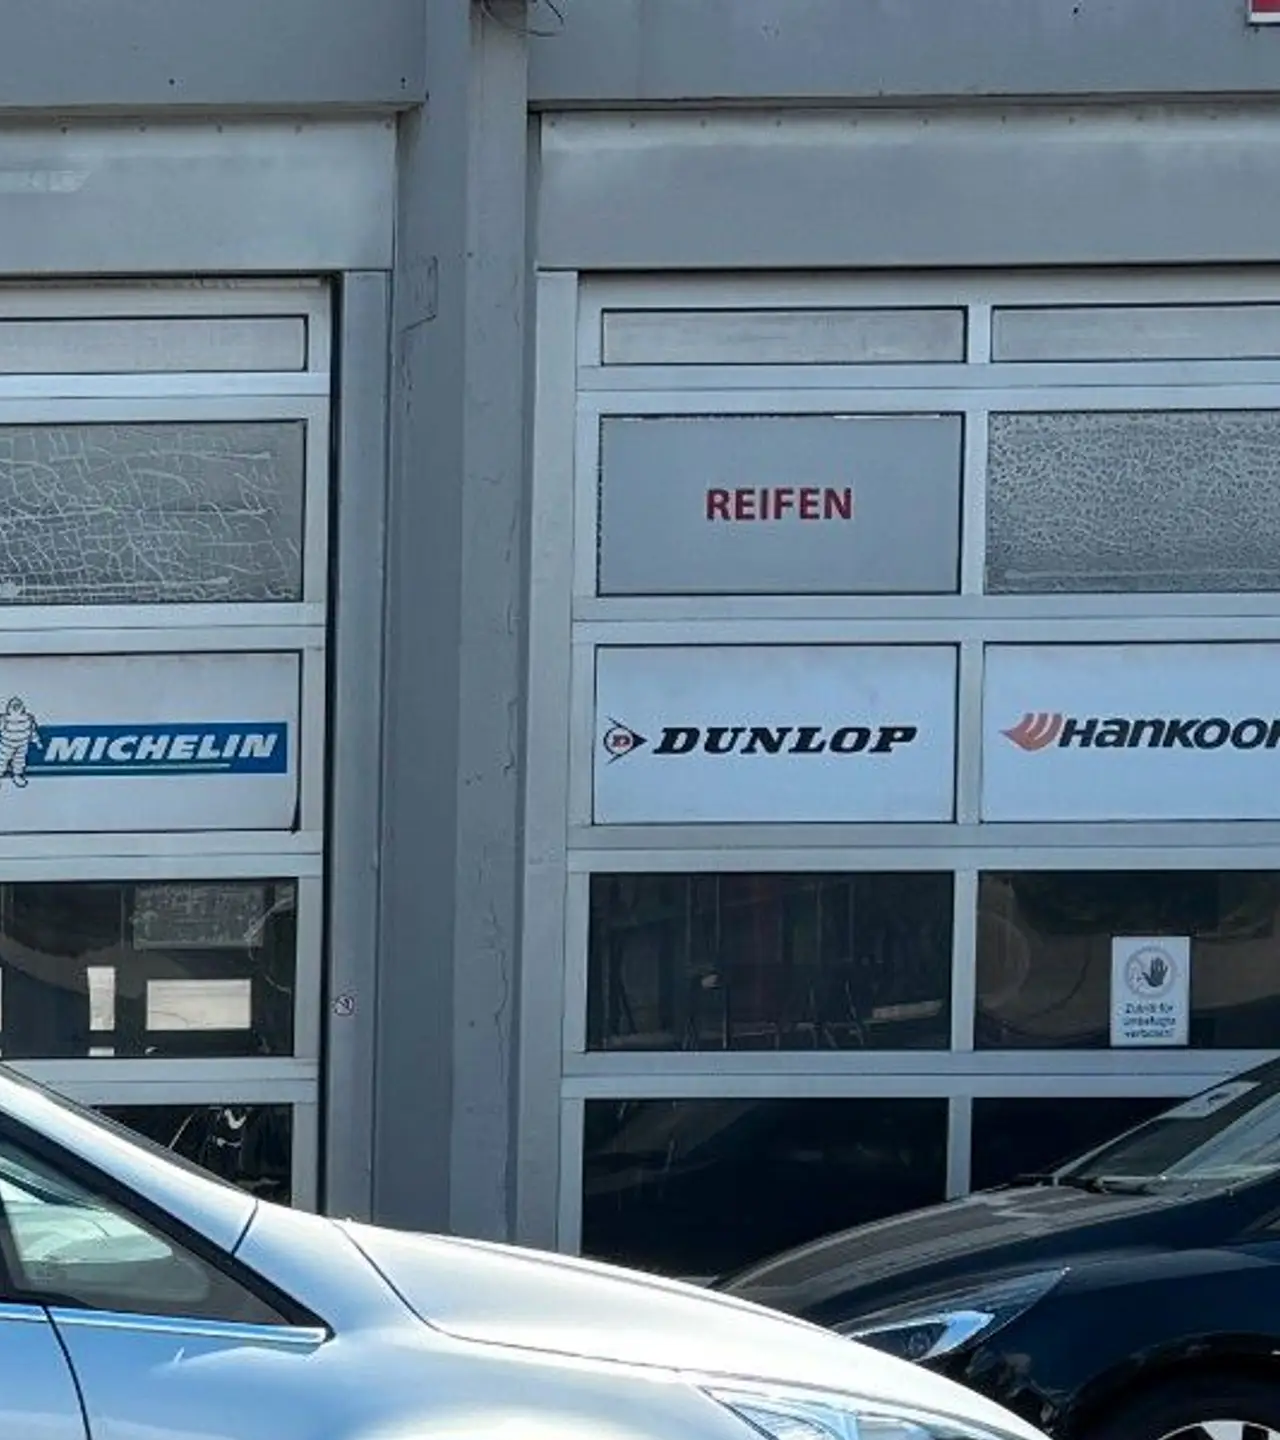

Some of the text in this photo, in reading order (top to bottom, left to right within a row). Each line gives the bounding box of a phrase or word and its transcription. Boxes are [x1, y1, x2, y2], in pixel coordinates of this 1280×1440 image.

[706, 488, 852, 521] REIFEN
[44, 734, 278, 762] MICHELIN
[653, 727, 917, 754] DUNLOP
